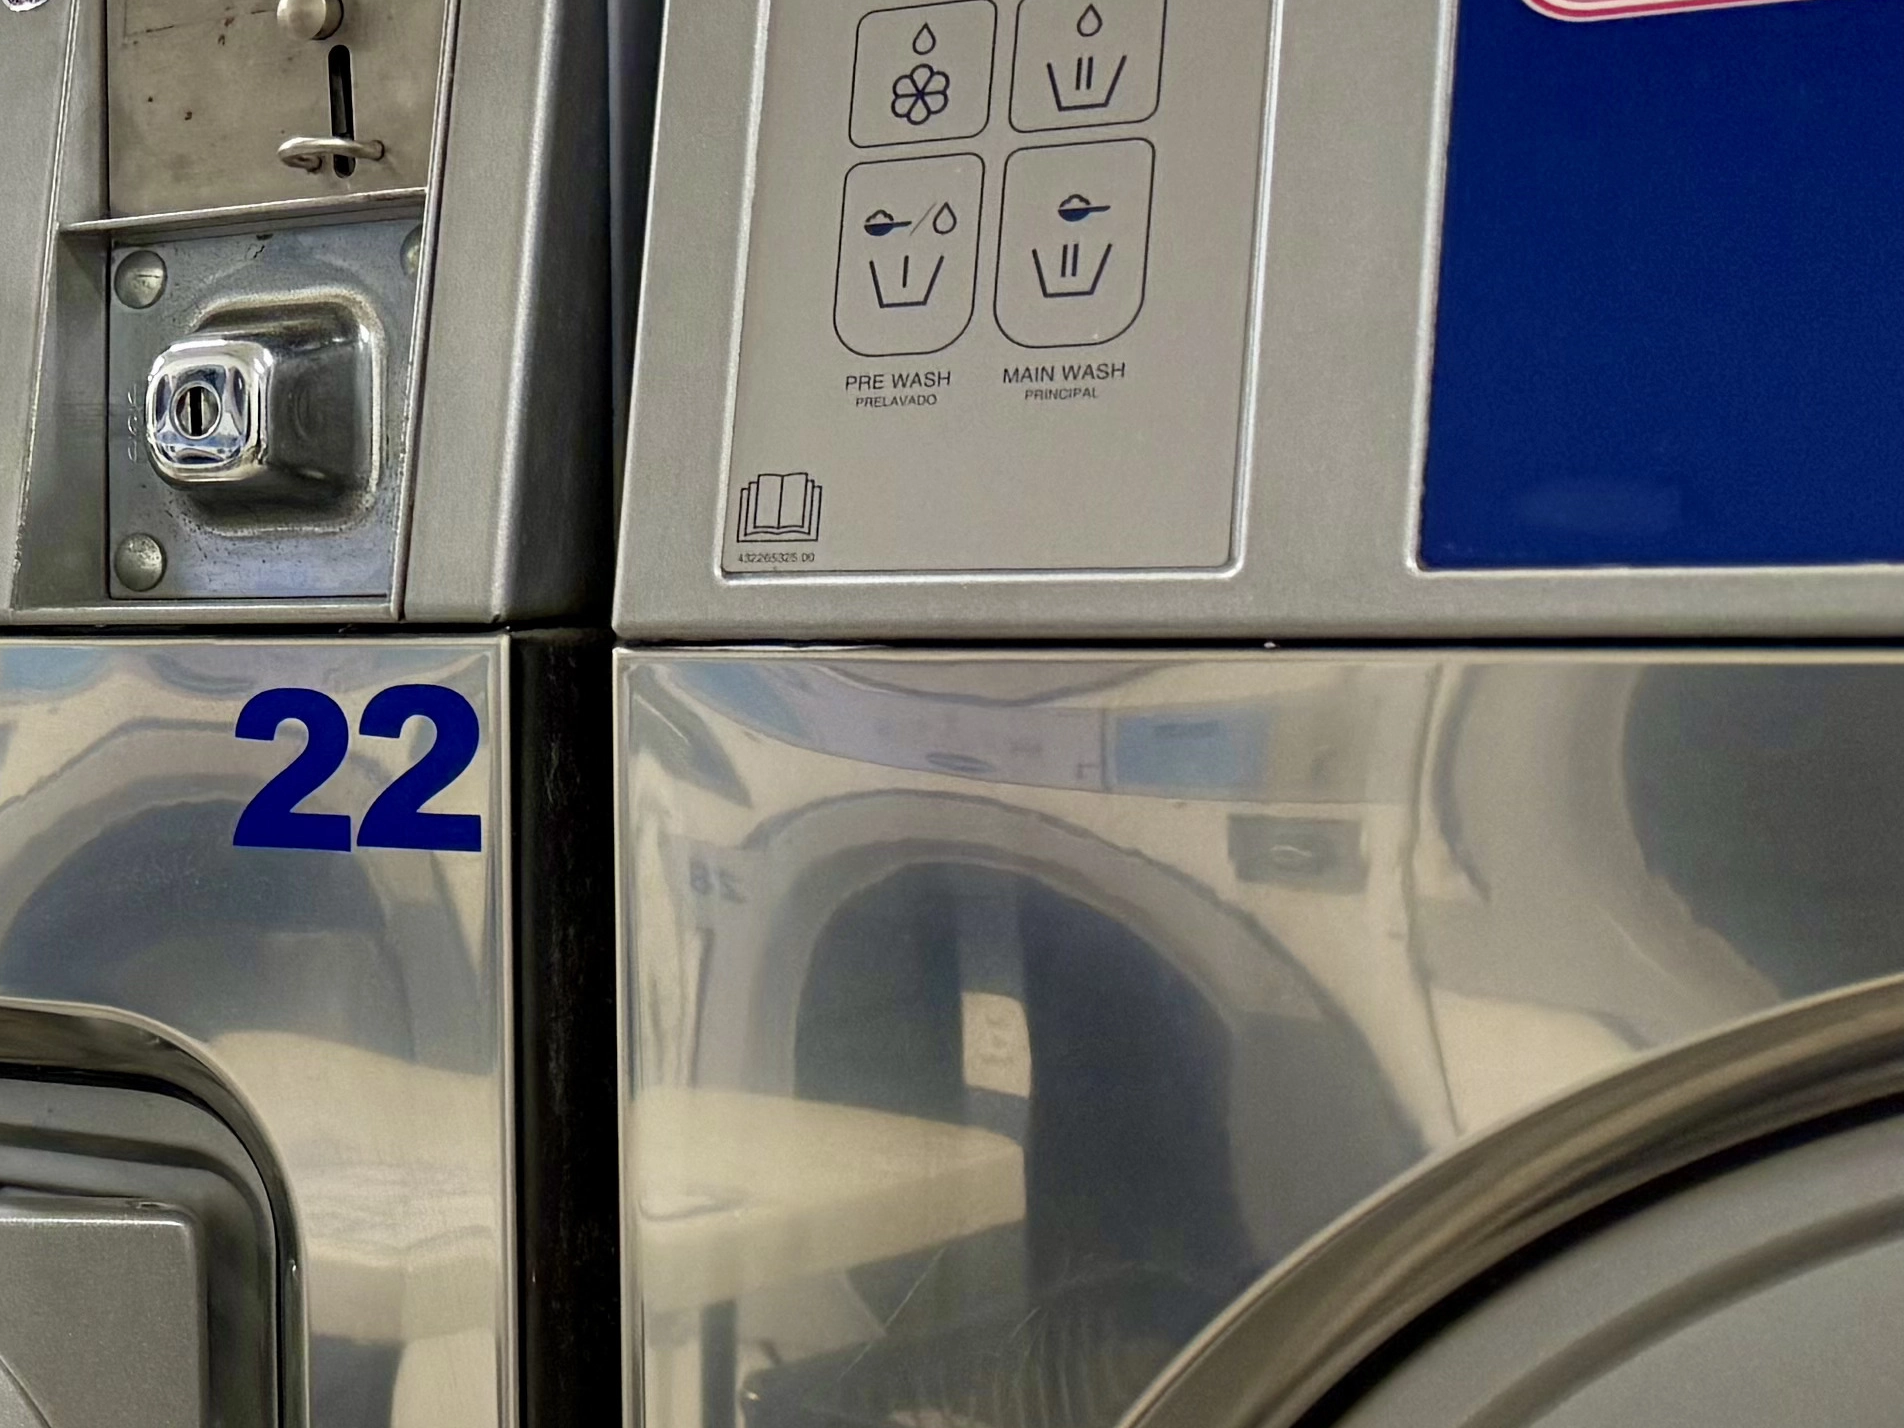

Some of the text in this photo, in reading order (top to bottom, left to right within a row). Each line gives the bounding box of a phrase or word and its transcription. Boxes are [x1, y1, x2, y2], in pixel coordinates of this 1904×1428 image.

[845, 370, 952, 391] PRE WASH
[1003, 362, 1126, 384] MAIN WASH
[855, 393, 937, 408] PRELAVADO
[1024, 387, 1097, 401] PRINCIPAL
[233, 683, 482, 852] 22
